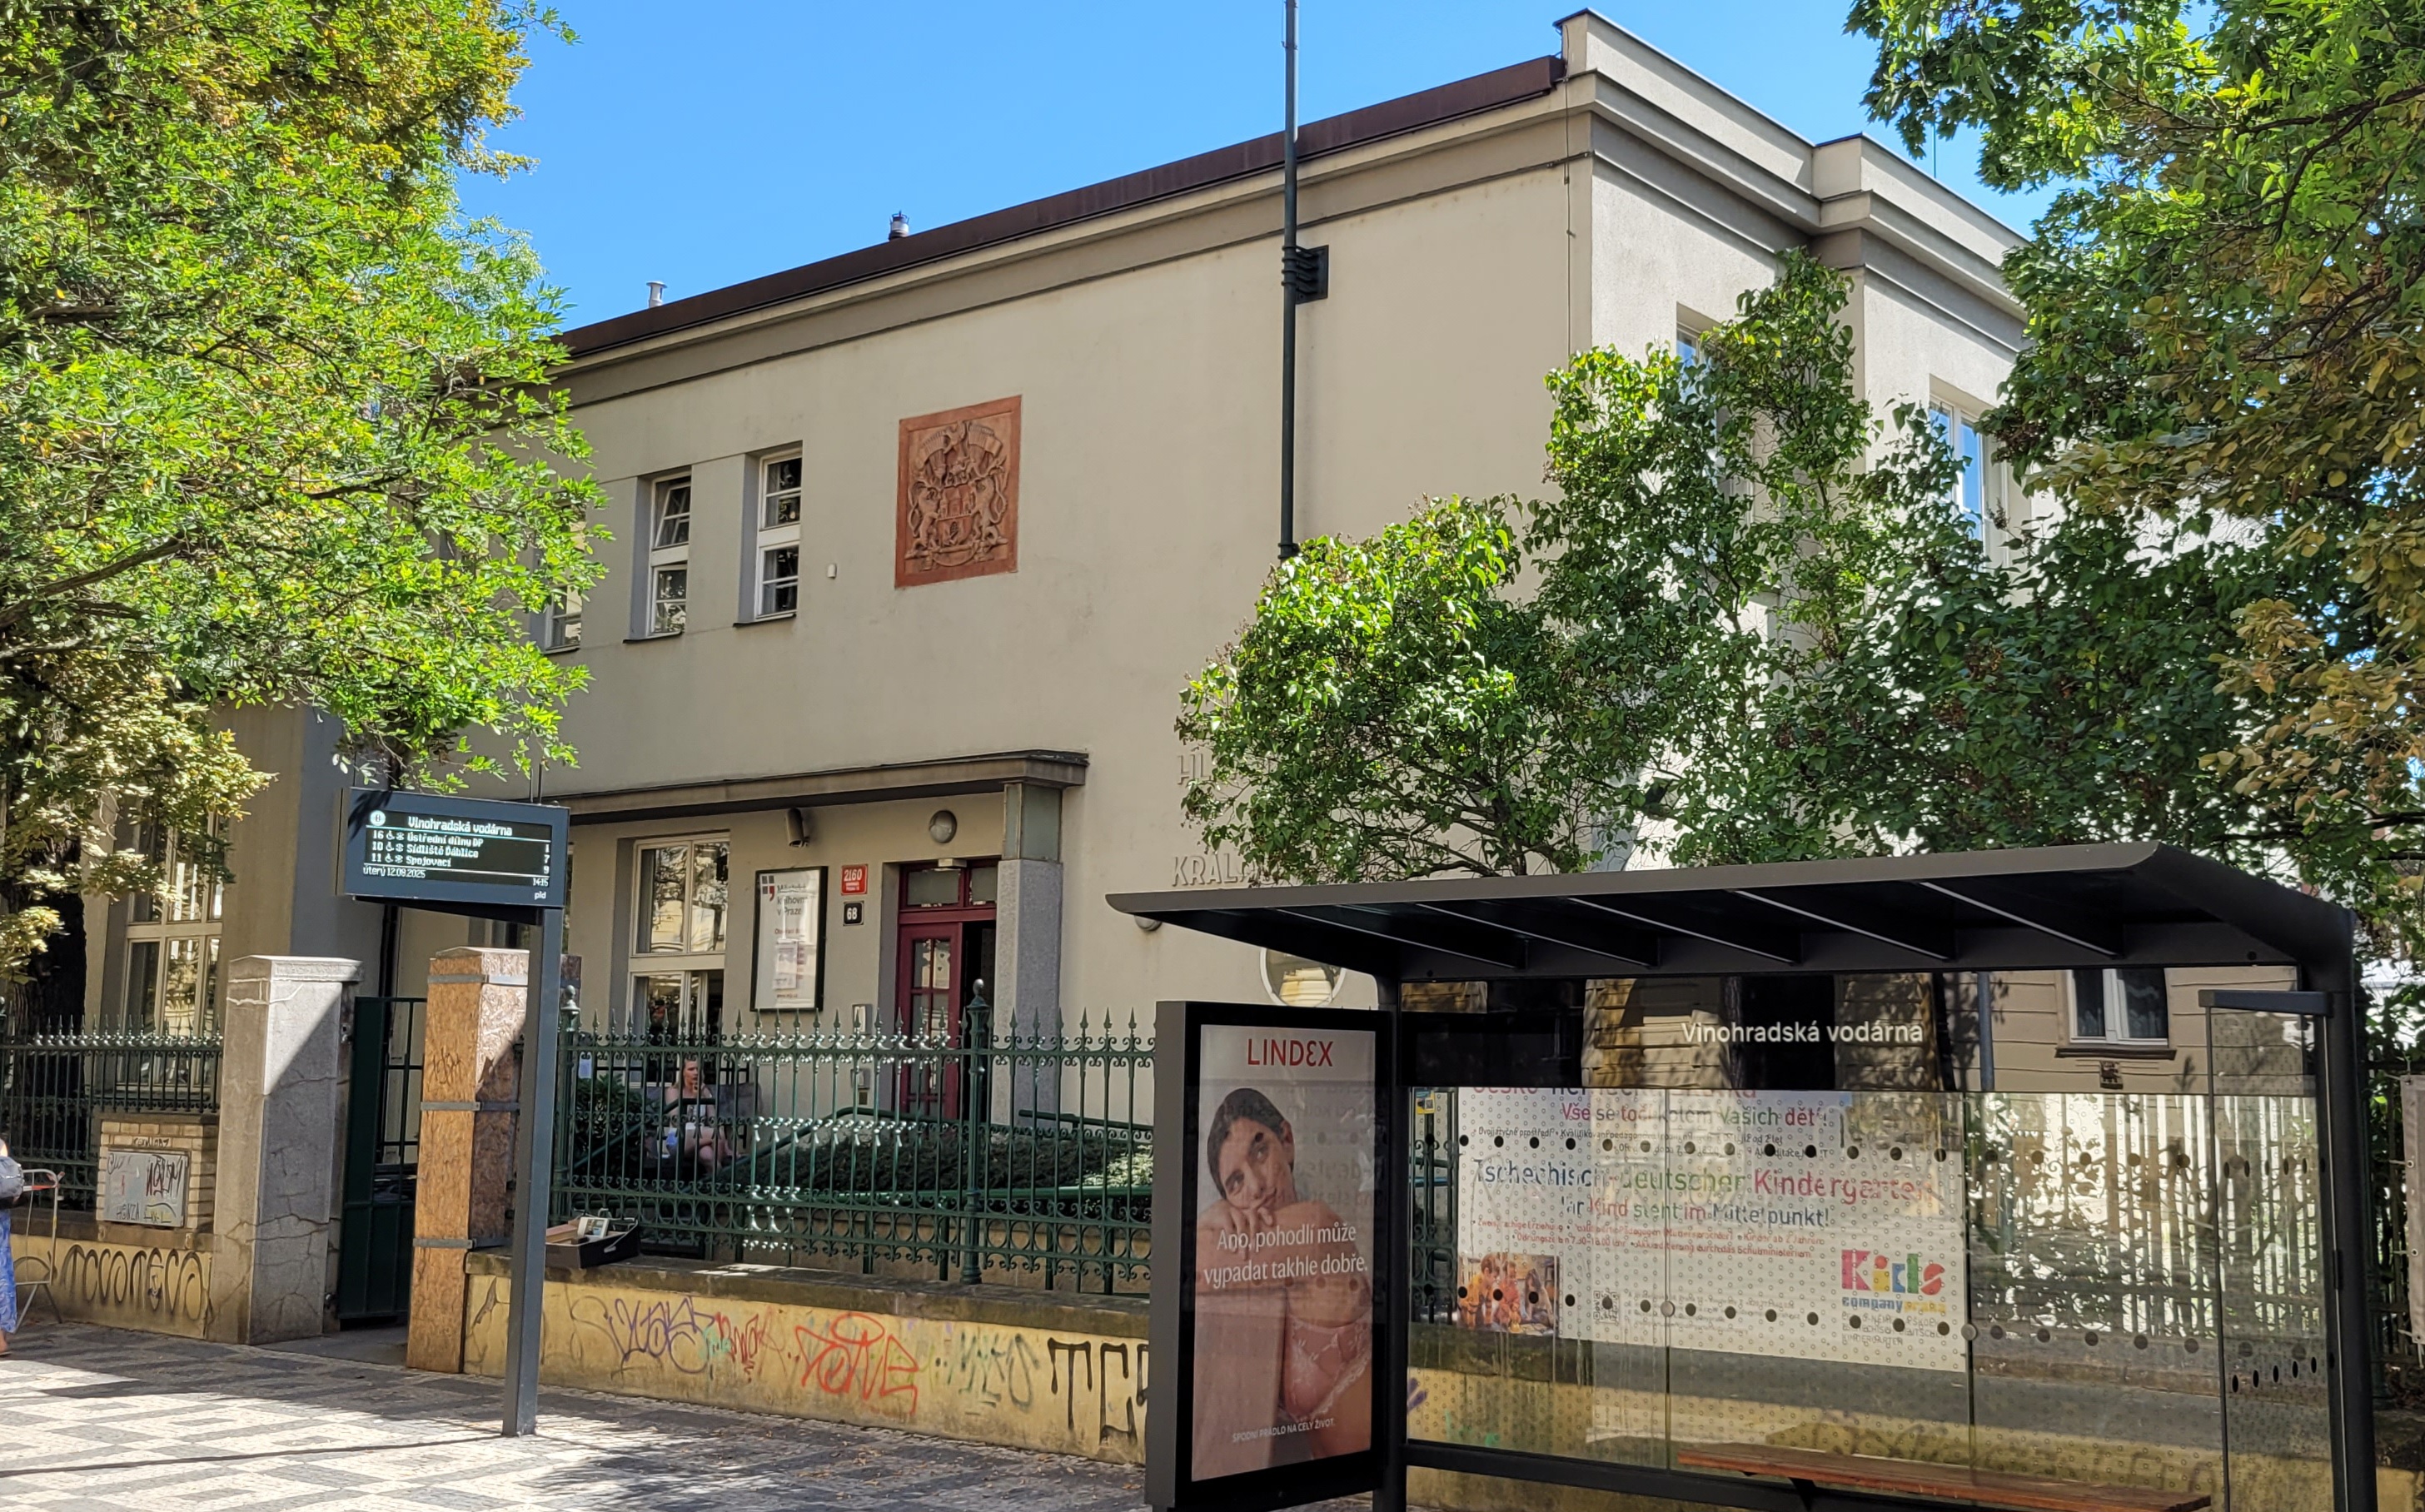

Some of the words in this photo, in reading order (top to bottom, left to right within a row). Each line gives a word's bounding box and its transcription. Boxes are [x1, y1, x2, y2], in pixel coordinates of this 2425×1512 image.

[408, 816, 471, 833] Vinohradská
[472, 823, 513, 837] vodárna
[372, 829, 385, 839] 16
[472, 838, 484, 848] DP
[371, 841, 384, 851] 10
[406, 843, 444, 856] Sídliště
[544, 854, 550, 863] 7
[371, 853, 382, 863] 11
[406, 855, 451, 868] Spojovací
[543, 865, 550, 874] 9
[844, 868, 863, 882] 2160
[847, 907, 858, 920] 68
[1681, 1020, 1820, 1042] Vinohradská
[1826, 1020, 1924, 1042] vodárna
[1247, 1038, 1334, 1067] LINDEX
[1561, 1102, 1591, 1122] Vše
[1596, 1108, 1616, 1122] se
[1718, 1104, 1779, 1126] Vašich
[1755, 1169, 1933, 1205] Kindergarten
[1589, 1196, 1629, 1217] Kind
[1633, 1200, 1679, 1220] steht
[1684, 1201, 1706, 1221] im
[1256, 1223, 1315, 1252] pohodlí
[1317, 1221, 1357, 1244] může
[1204, 1260, 1268, 1289] vypadat
[1272, 1255, 1318, 1280] takhle
[1321, 1252, 1368, 1276] dobře.
[1842, 1250, 1945, 1296] Kids
[1842, 1296, 1903, 1314] company
[1287, 1423, 1297, 1434] NA
